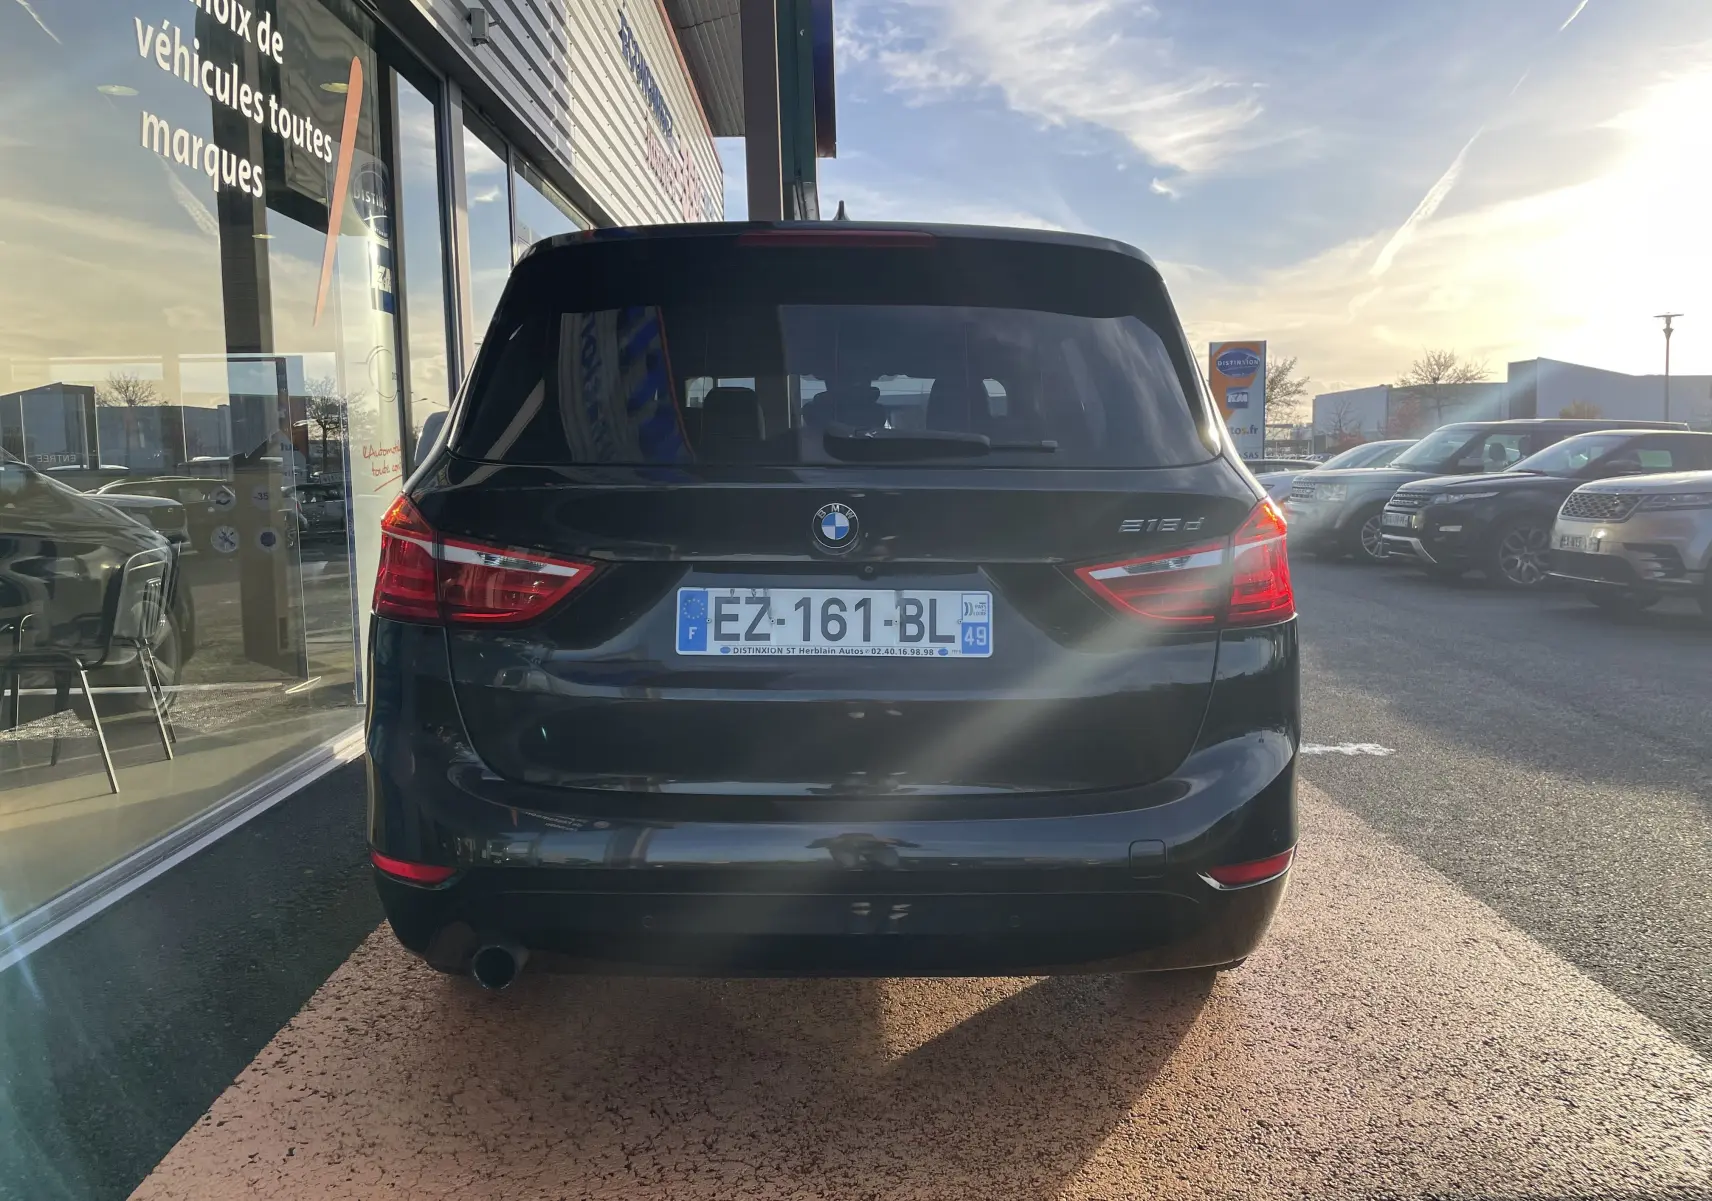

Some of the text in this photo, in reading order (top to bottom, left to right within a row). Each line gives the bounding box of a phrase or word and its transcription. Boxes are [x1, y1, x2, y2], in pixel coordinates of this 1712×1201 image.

[257, 11, 283, 64] de
[135, 17, 332, 163] véhicules toutes
[141, 110, 263, 198] marques
[816, 504, 856, 519] BMW
[688, 626, 698, 640] F
[714, 597, 955, 643] EZ-161-BL
[964, 626, 987, 646] 49
[733, 647, 783, 655] DISTINXION
[871, 648, 934, 656] 02.40.16.98.98
